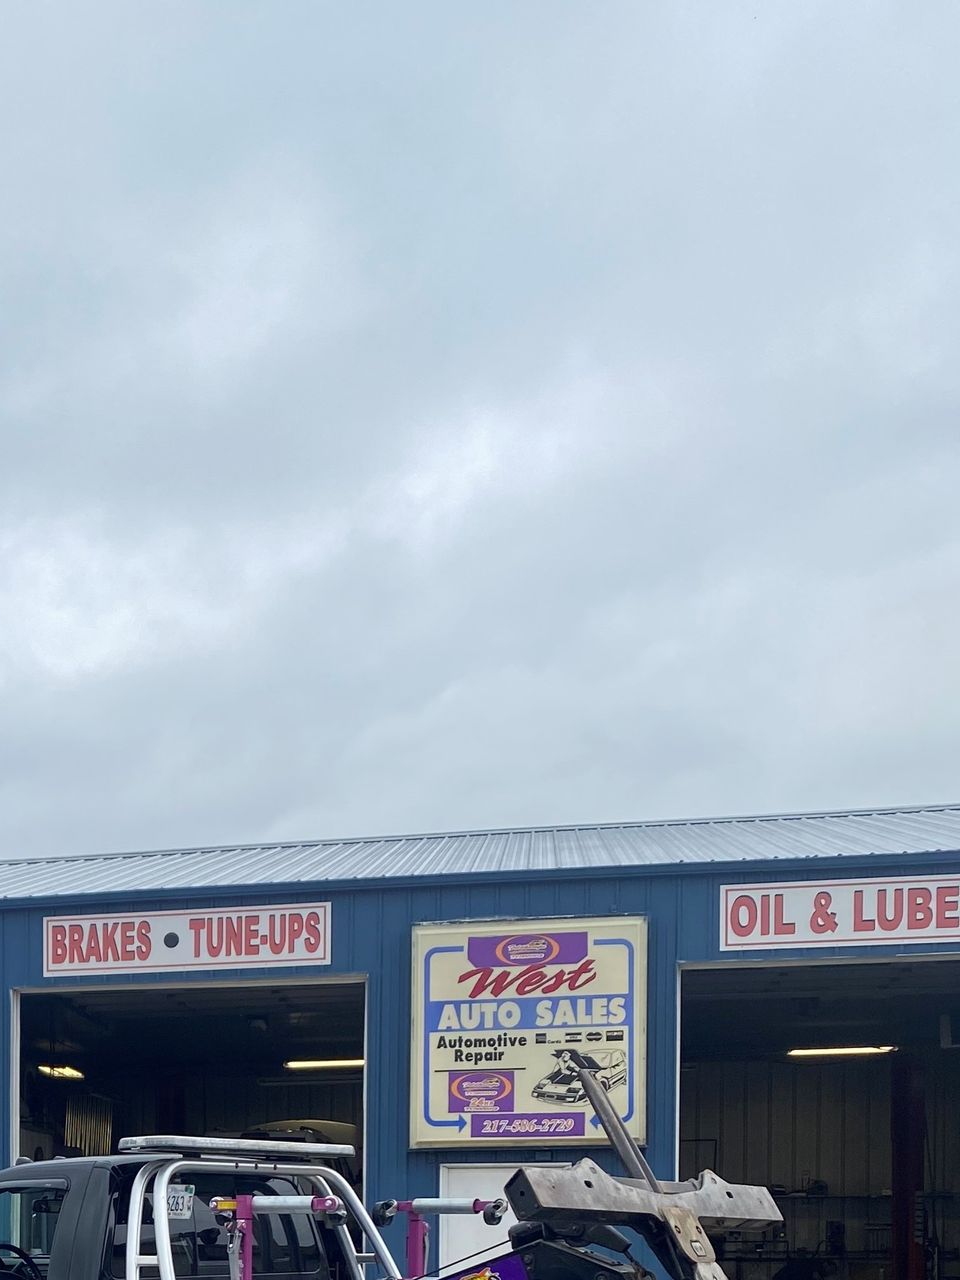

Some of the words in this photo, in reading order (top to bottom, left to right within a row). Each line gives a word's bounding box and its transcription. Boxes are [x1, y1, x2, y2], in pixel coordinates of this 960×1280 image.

[730, 895, 796, 937] OIL
[810, 891, 839, 934] &
[853, 886, 959, 932] LUBE
[51, 921, 152, 965] BRAKES
[189, 912, 321, 958] TUNE-UPS
[457, 959, 597, 999] West
[437, 1001, 522, 1031] AUTO
[535, 997, 626, 1027] SALES
[436, 1033, 528, 1050] Automotive
[454, 1047, 505, 1066] Repair
[481, 1118, 575, 1133] 217-586-2729
